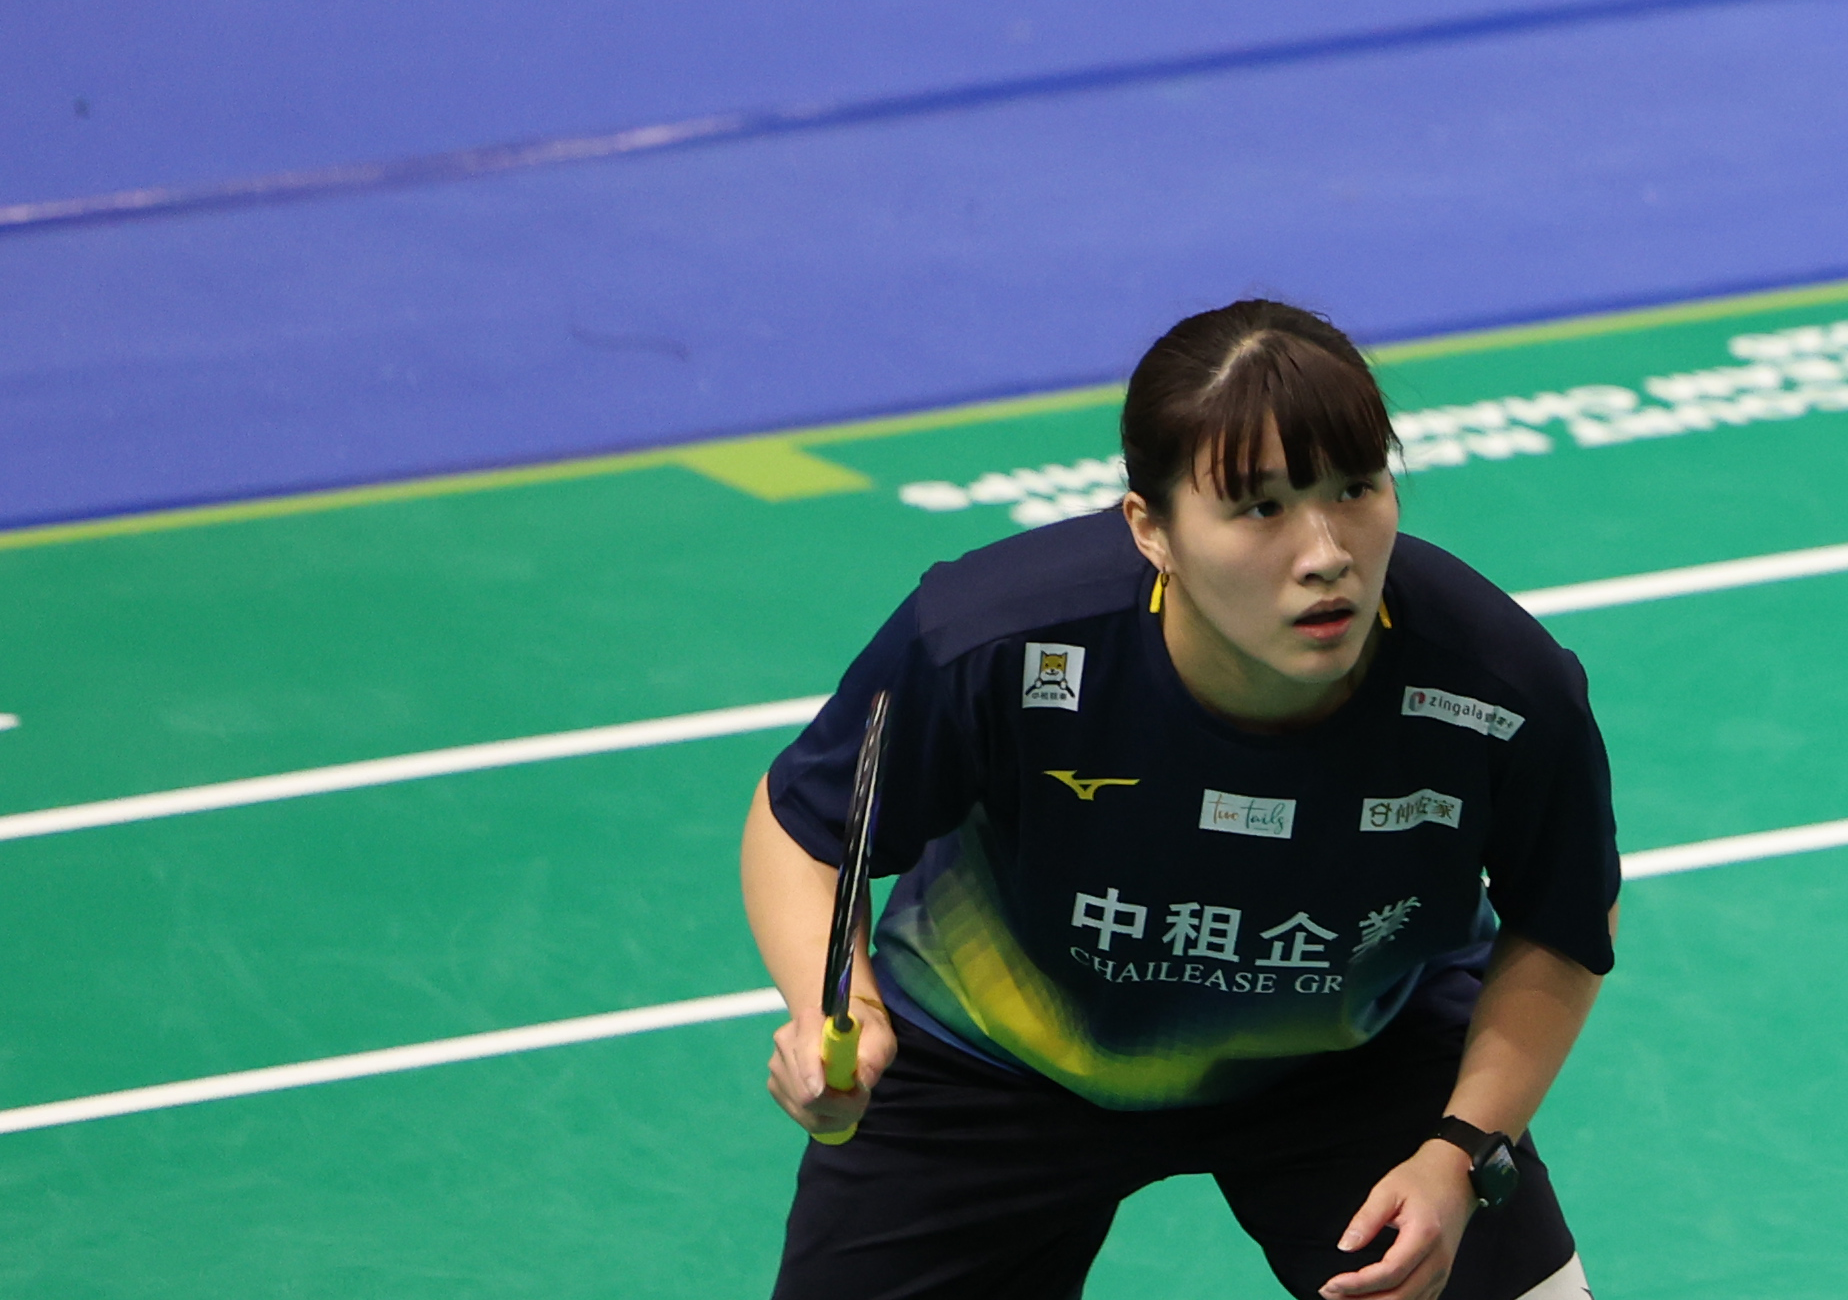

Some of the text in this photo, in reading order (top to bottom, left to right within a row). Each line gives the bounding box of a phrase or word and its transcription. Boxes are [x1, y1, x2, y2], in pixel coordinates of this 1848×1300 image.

[1428, 695, 1484, 721] zingala
[1240, 798, 1286, 835] tails
[1070, 945, 1344, 995] CHAILEASE GR
